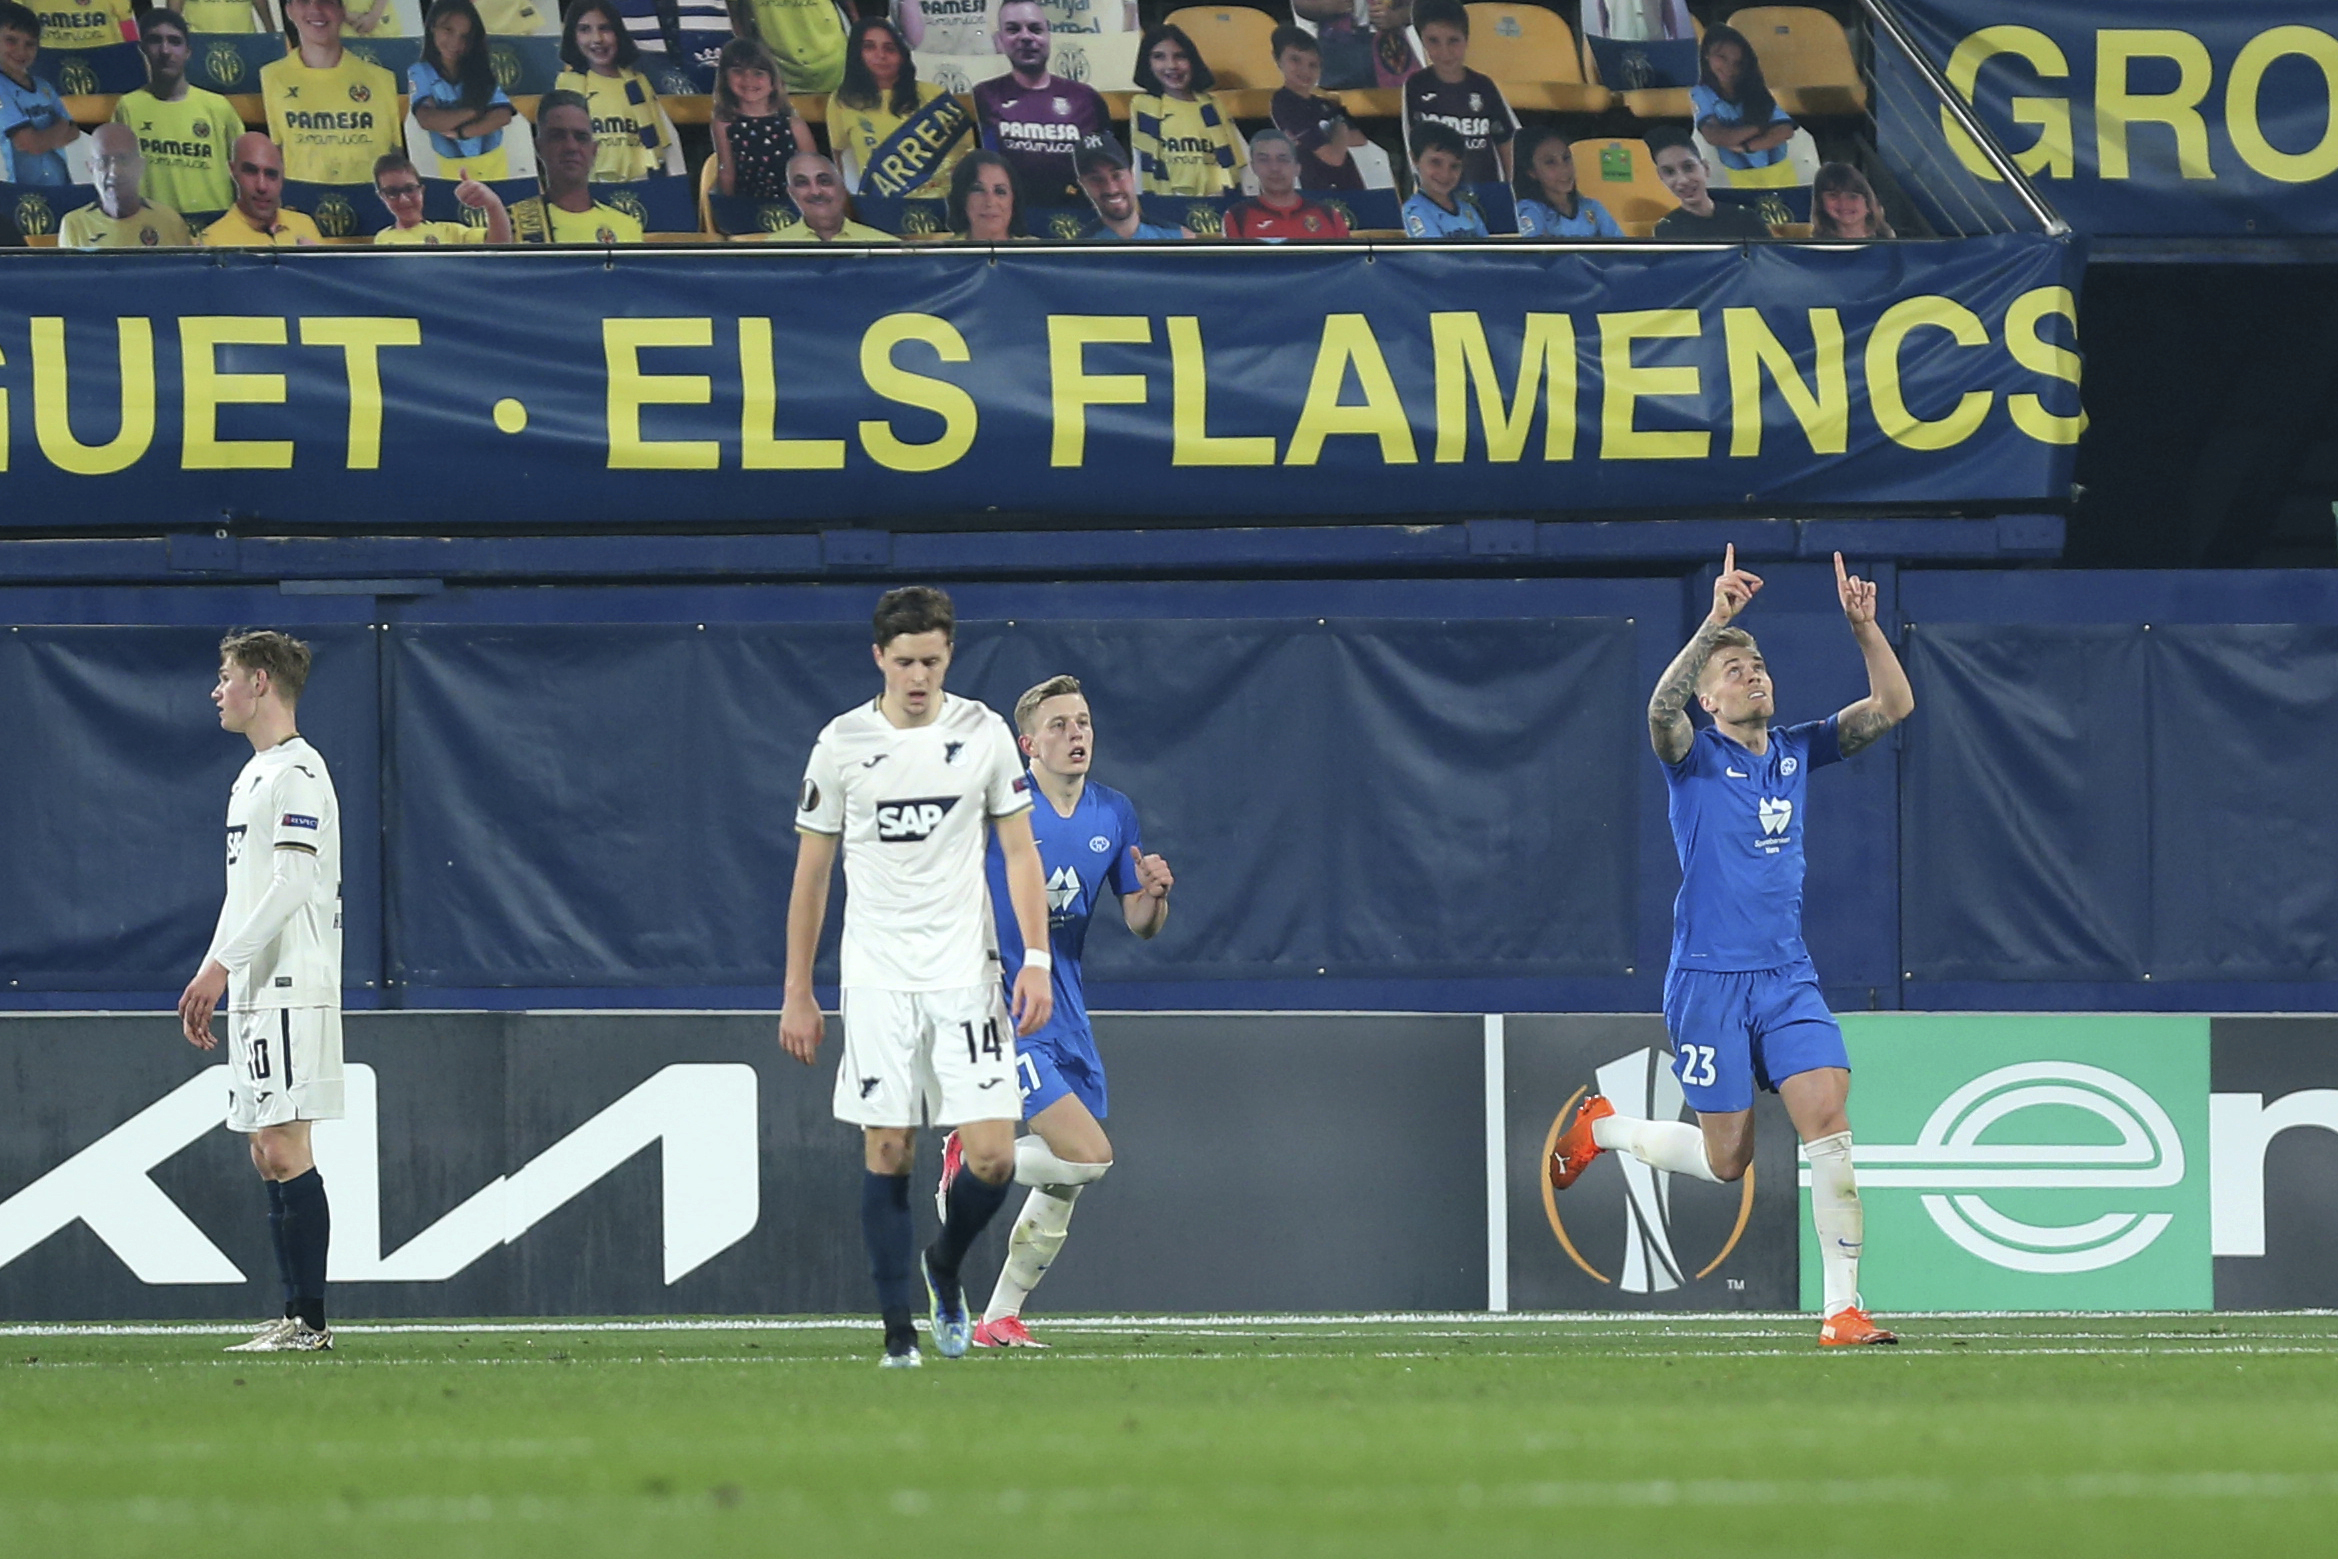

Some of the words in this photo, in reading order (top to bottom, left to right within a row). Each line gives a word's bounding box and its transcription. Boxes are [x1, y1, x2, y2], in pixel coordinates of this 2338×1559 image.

[39, 11, 107, 28] AMESA
[1940, 24, 2338, 184] GRO
[285, 111, 374, 129] PAMESA
[998, 121, 1080, 141] PAMESA
[139, 137, 212, 159] PAMESA
[0, 316, 421, 475] UET
[602, 312, 978, 472] ELS
[1047, 285, 2089, 469] FLAMENCS
[879, 803, 943, 836] SAP
[960, 1016, 1002, 1064] 14
[1680, 1043, 1716, 1088] 23
[1726, 1279, 1745, 1290] TM
